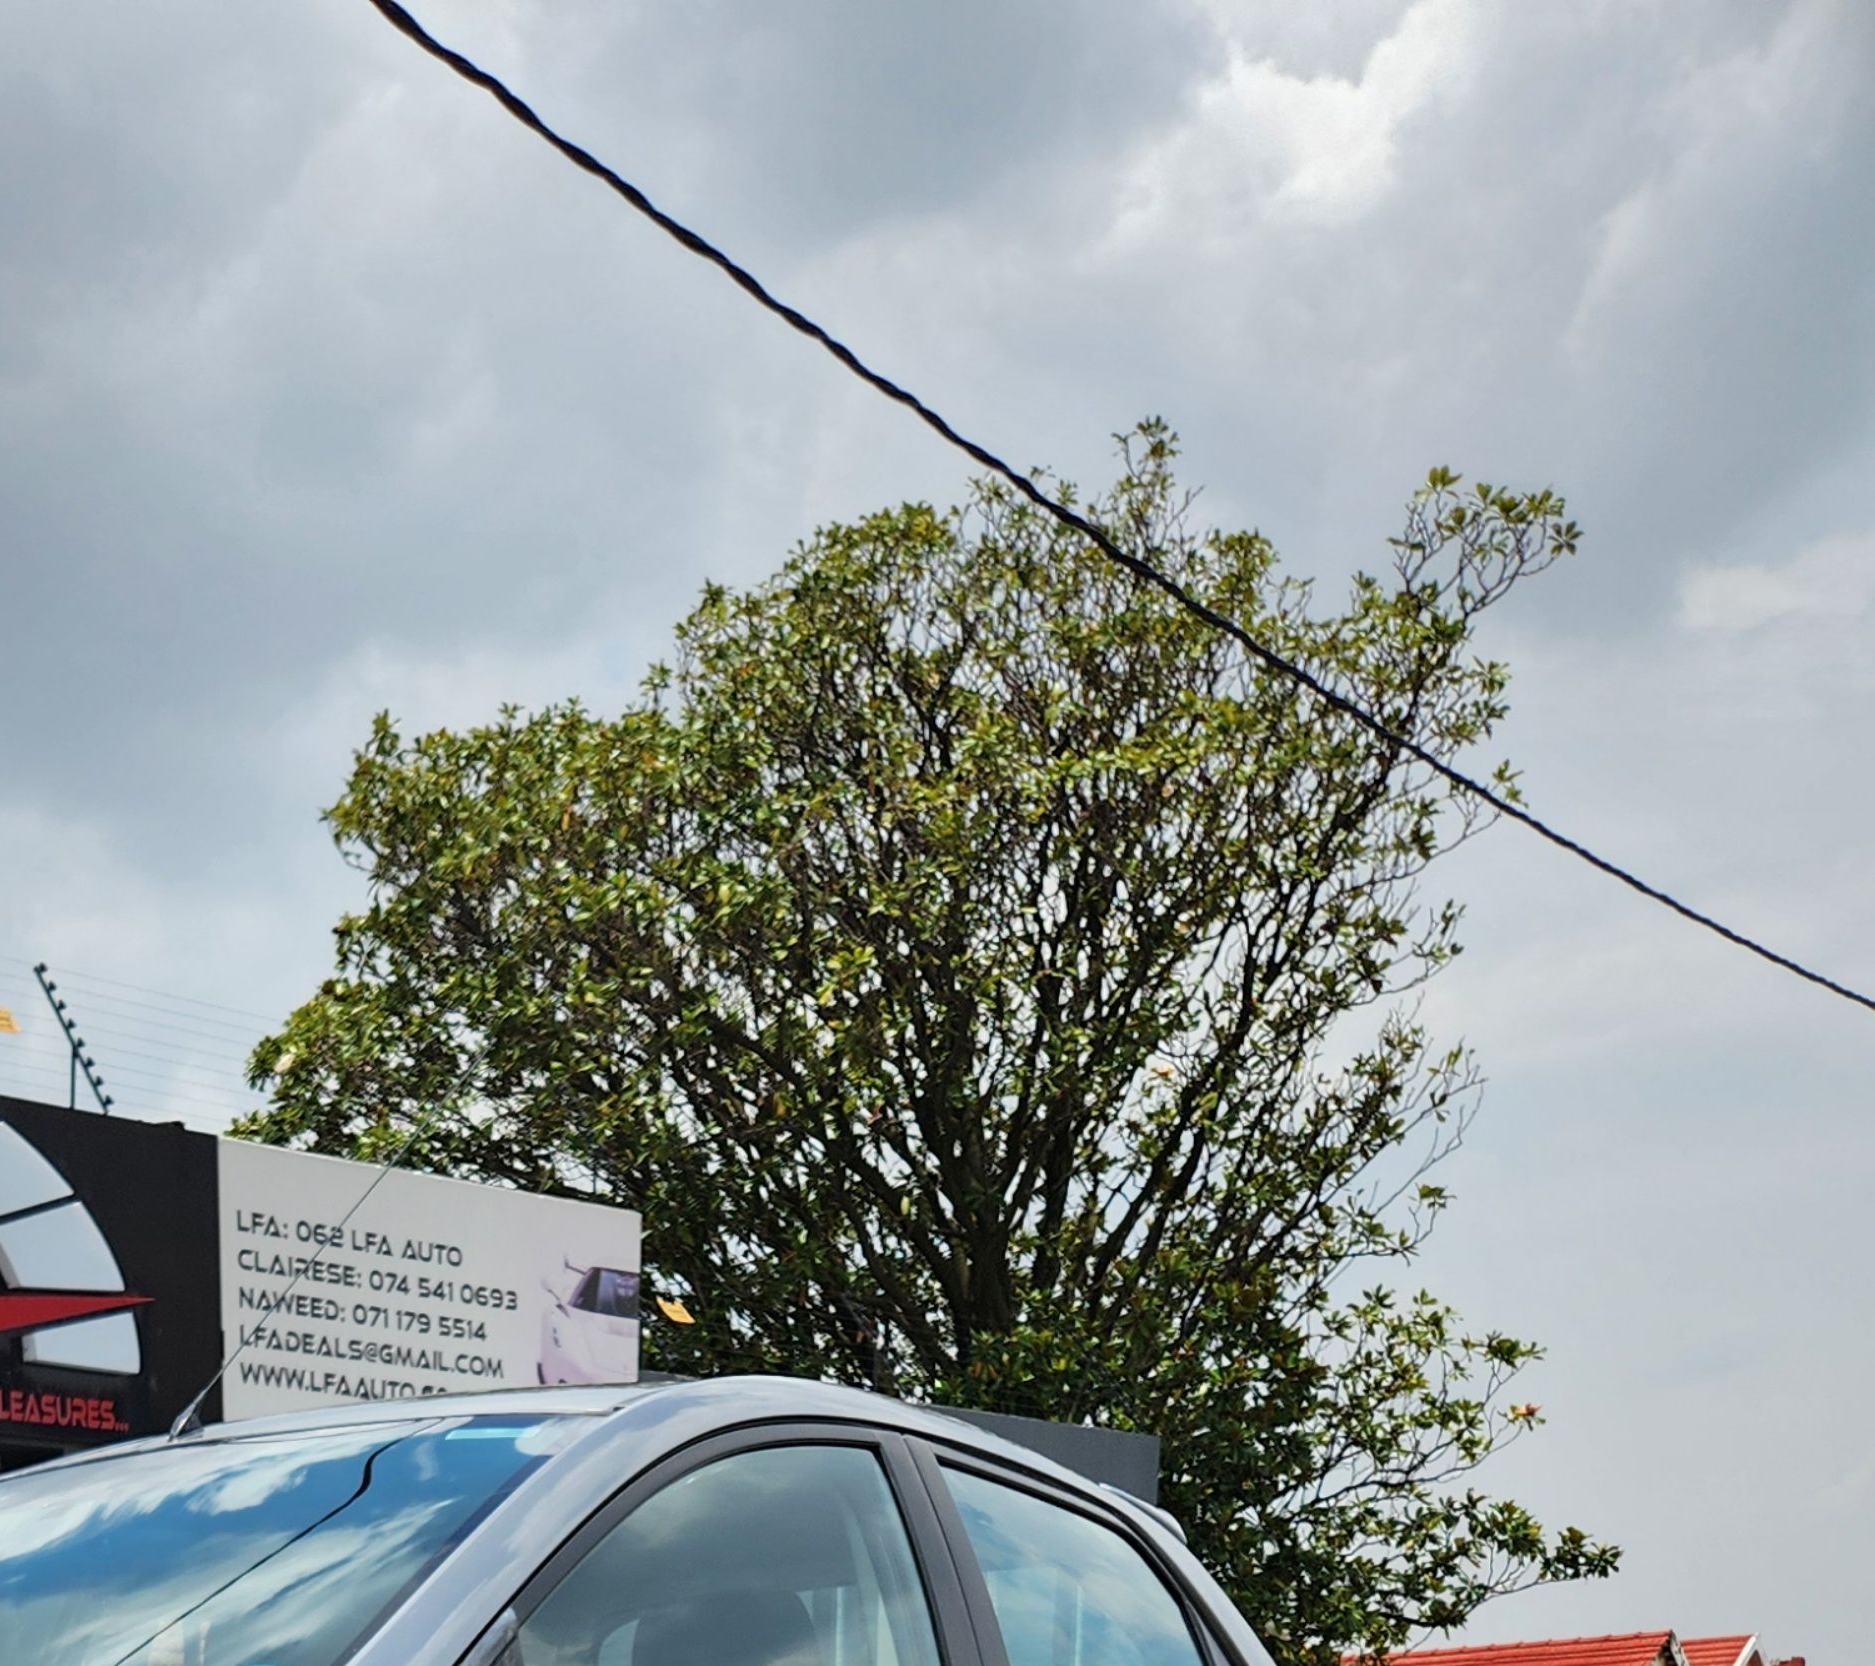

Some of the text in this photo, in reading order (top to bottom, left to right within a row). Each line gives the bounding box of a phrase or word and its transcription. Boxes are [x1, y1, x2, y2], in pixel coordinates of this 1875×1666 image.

[236, 1210, 463, 1267] LFA: 062 LFA AUTO
[237, 1249, 518, 1311] CLAIRESE: 074 541 0693
[238, 1286, 487, 1341] NAWEED: 071 179 5514
[238, 1324, 504, 1380] LFADEALS@GMAIL.COM
